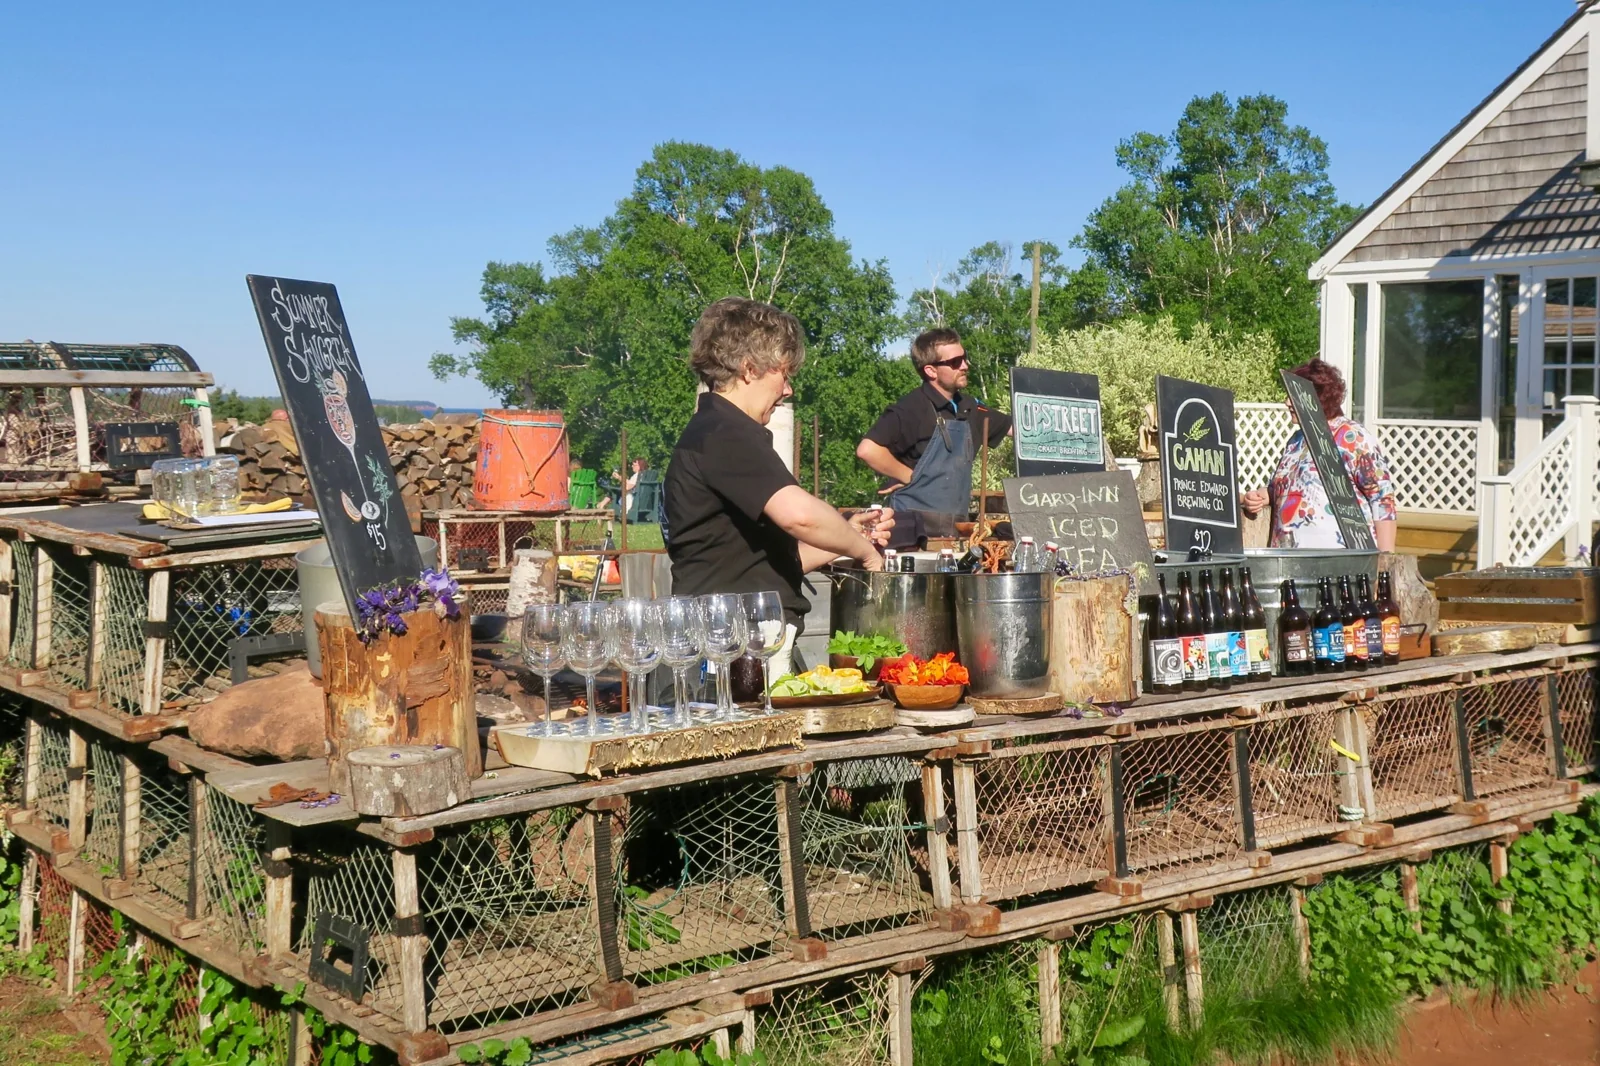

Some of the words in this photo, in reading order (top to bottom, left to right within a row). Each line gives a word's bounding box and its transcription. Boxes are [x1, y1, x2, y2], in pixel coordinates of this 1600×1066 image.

[271, 279, 343, 335] SUMMER
[284, 331, 364, 384] SANGRIA
[1021, 401, 1097, 434] UPSTREET
[1038, 445, 1057, 453] CRAFT
[1060, 446, 1088, 456] BREWING
[1173, 443, 1225, 476] GAHAN
[1173, 478, 1196, 493] PRINCE
[1200, 480, 1228, 497] EDWARD
[1177, 494, 1210, 510] BREWING
[1213, 498, 1224, 511] CO.
[366, 523, 386, 550] $15
[1049, 516, 1119, 540] ICED
[1058, 546, 1119, 574] TEA
